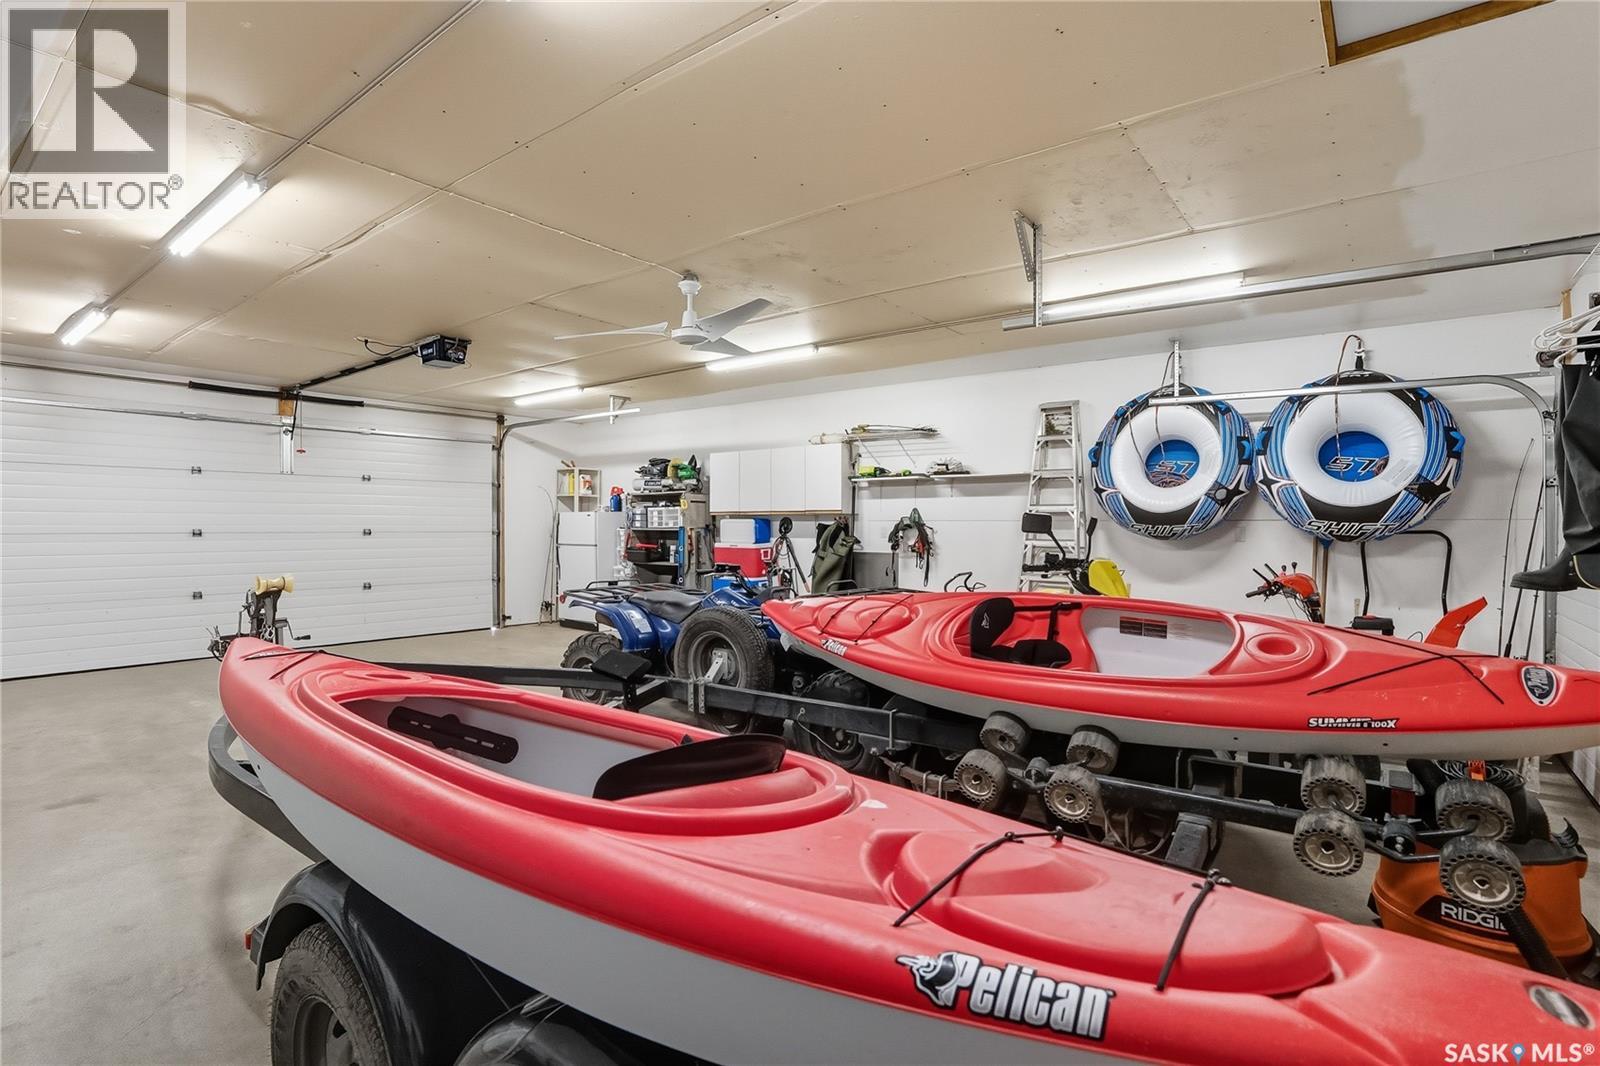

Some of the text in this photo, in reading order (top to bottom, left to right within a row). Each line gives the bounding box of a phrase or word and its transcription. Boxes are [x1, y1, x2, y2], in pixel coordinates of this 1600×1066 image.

[1128, 523, 1203, 541] SHIFT
[1304, 520, 1399, 541] SHIFT
[1440, 902, 1507, 931] RIDGI
[939, 952, 1108, 1039] Pelican
